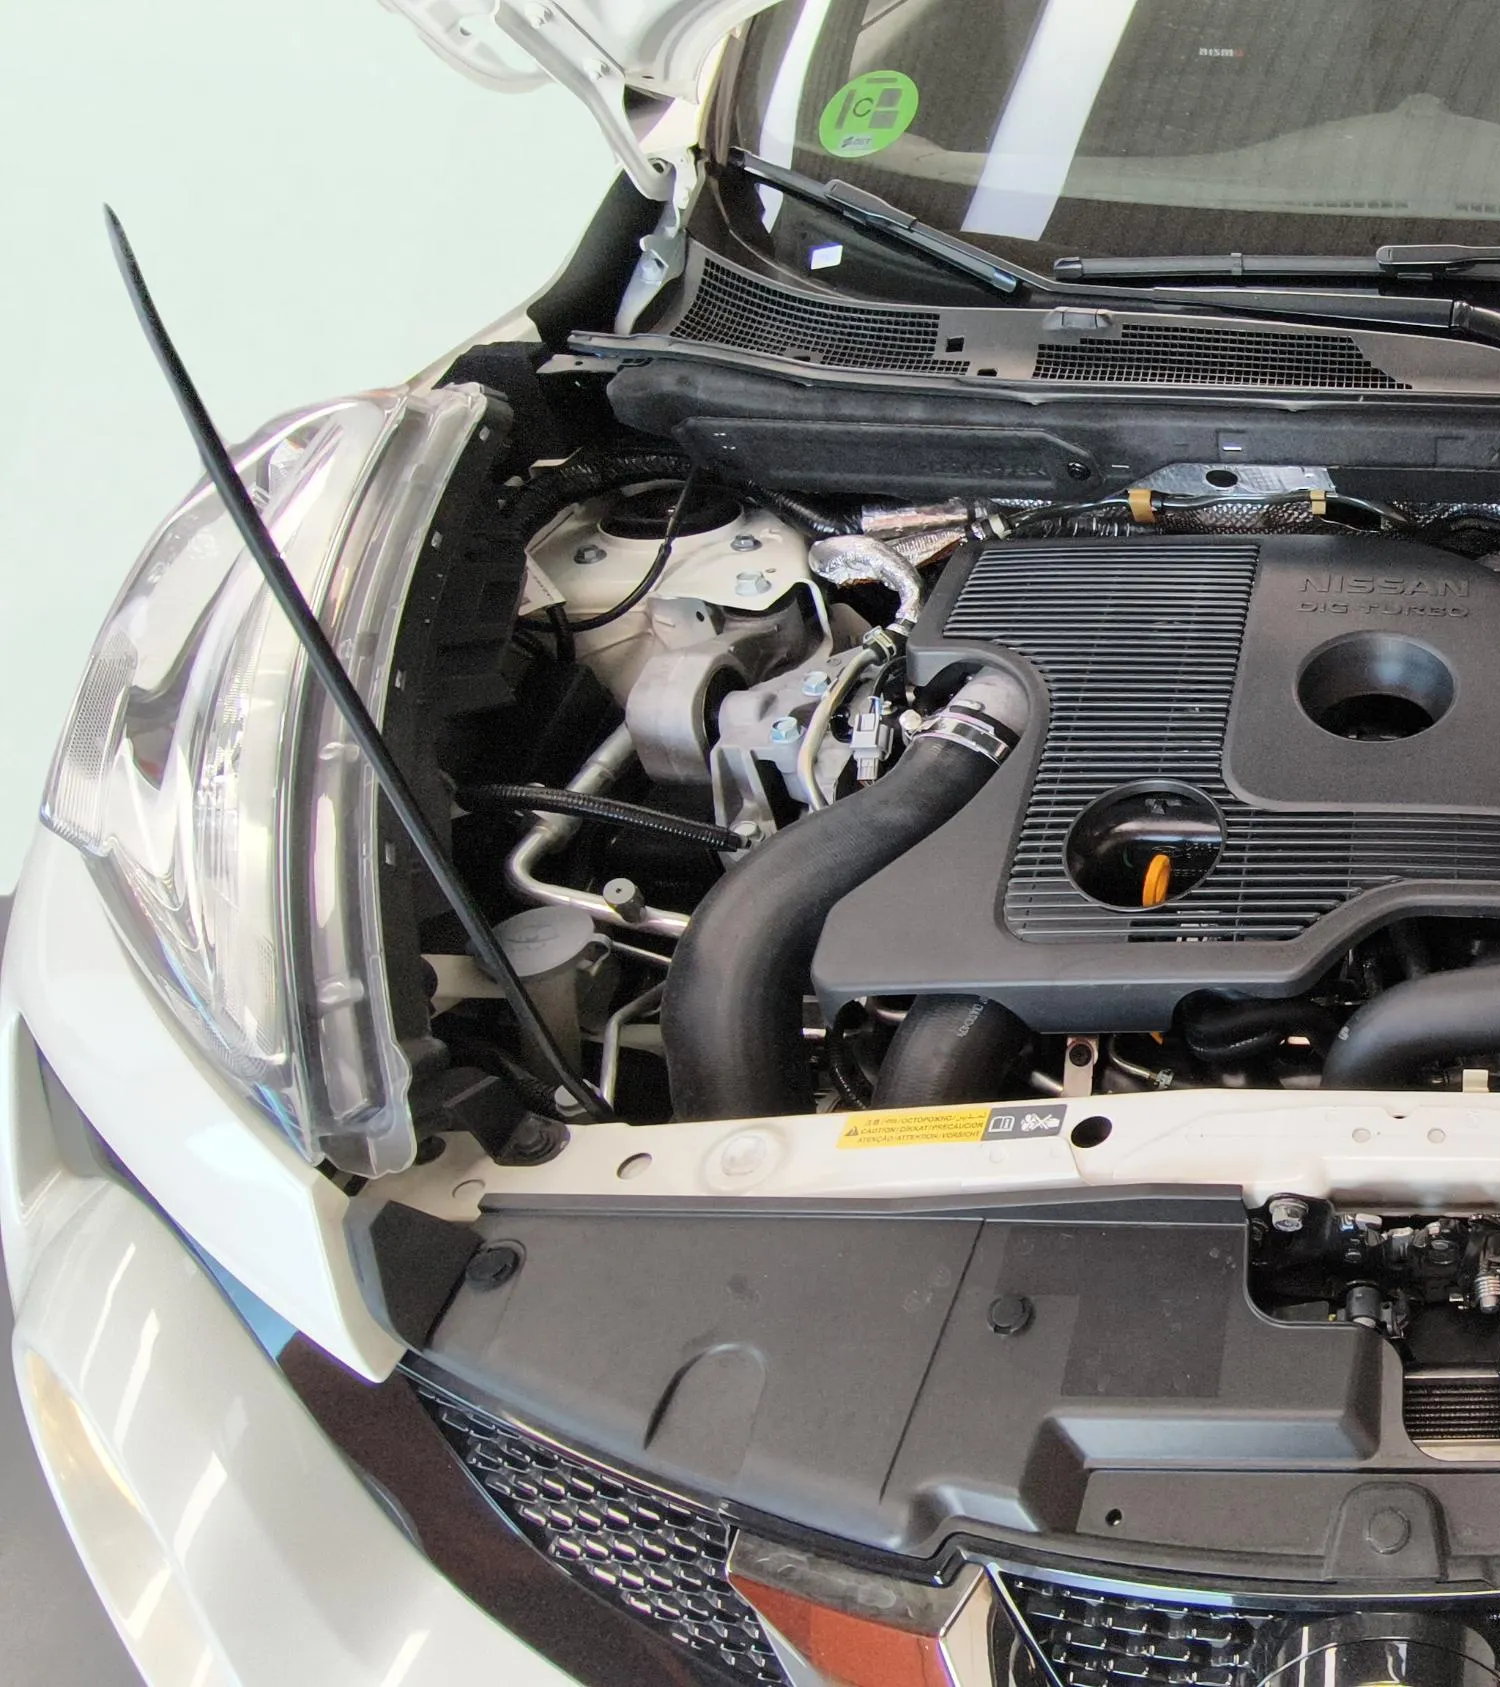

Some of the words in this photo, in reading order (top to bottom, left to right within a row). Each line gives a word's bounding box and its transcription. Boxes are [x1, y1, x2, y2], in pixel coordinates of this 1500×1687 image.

[853, 97, 873, 117] C
[1298, 574, 1471, 597] NISSAN
[1297, 602, 1349, 614] DIG
[1360, 604, 1470, 618] TURBO
